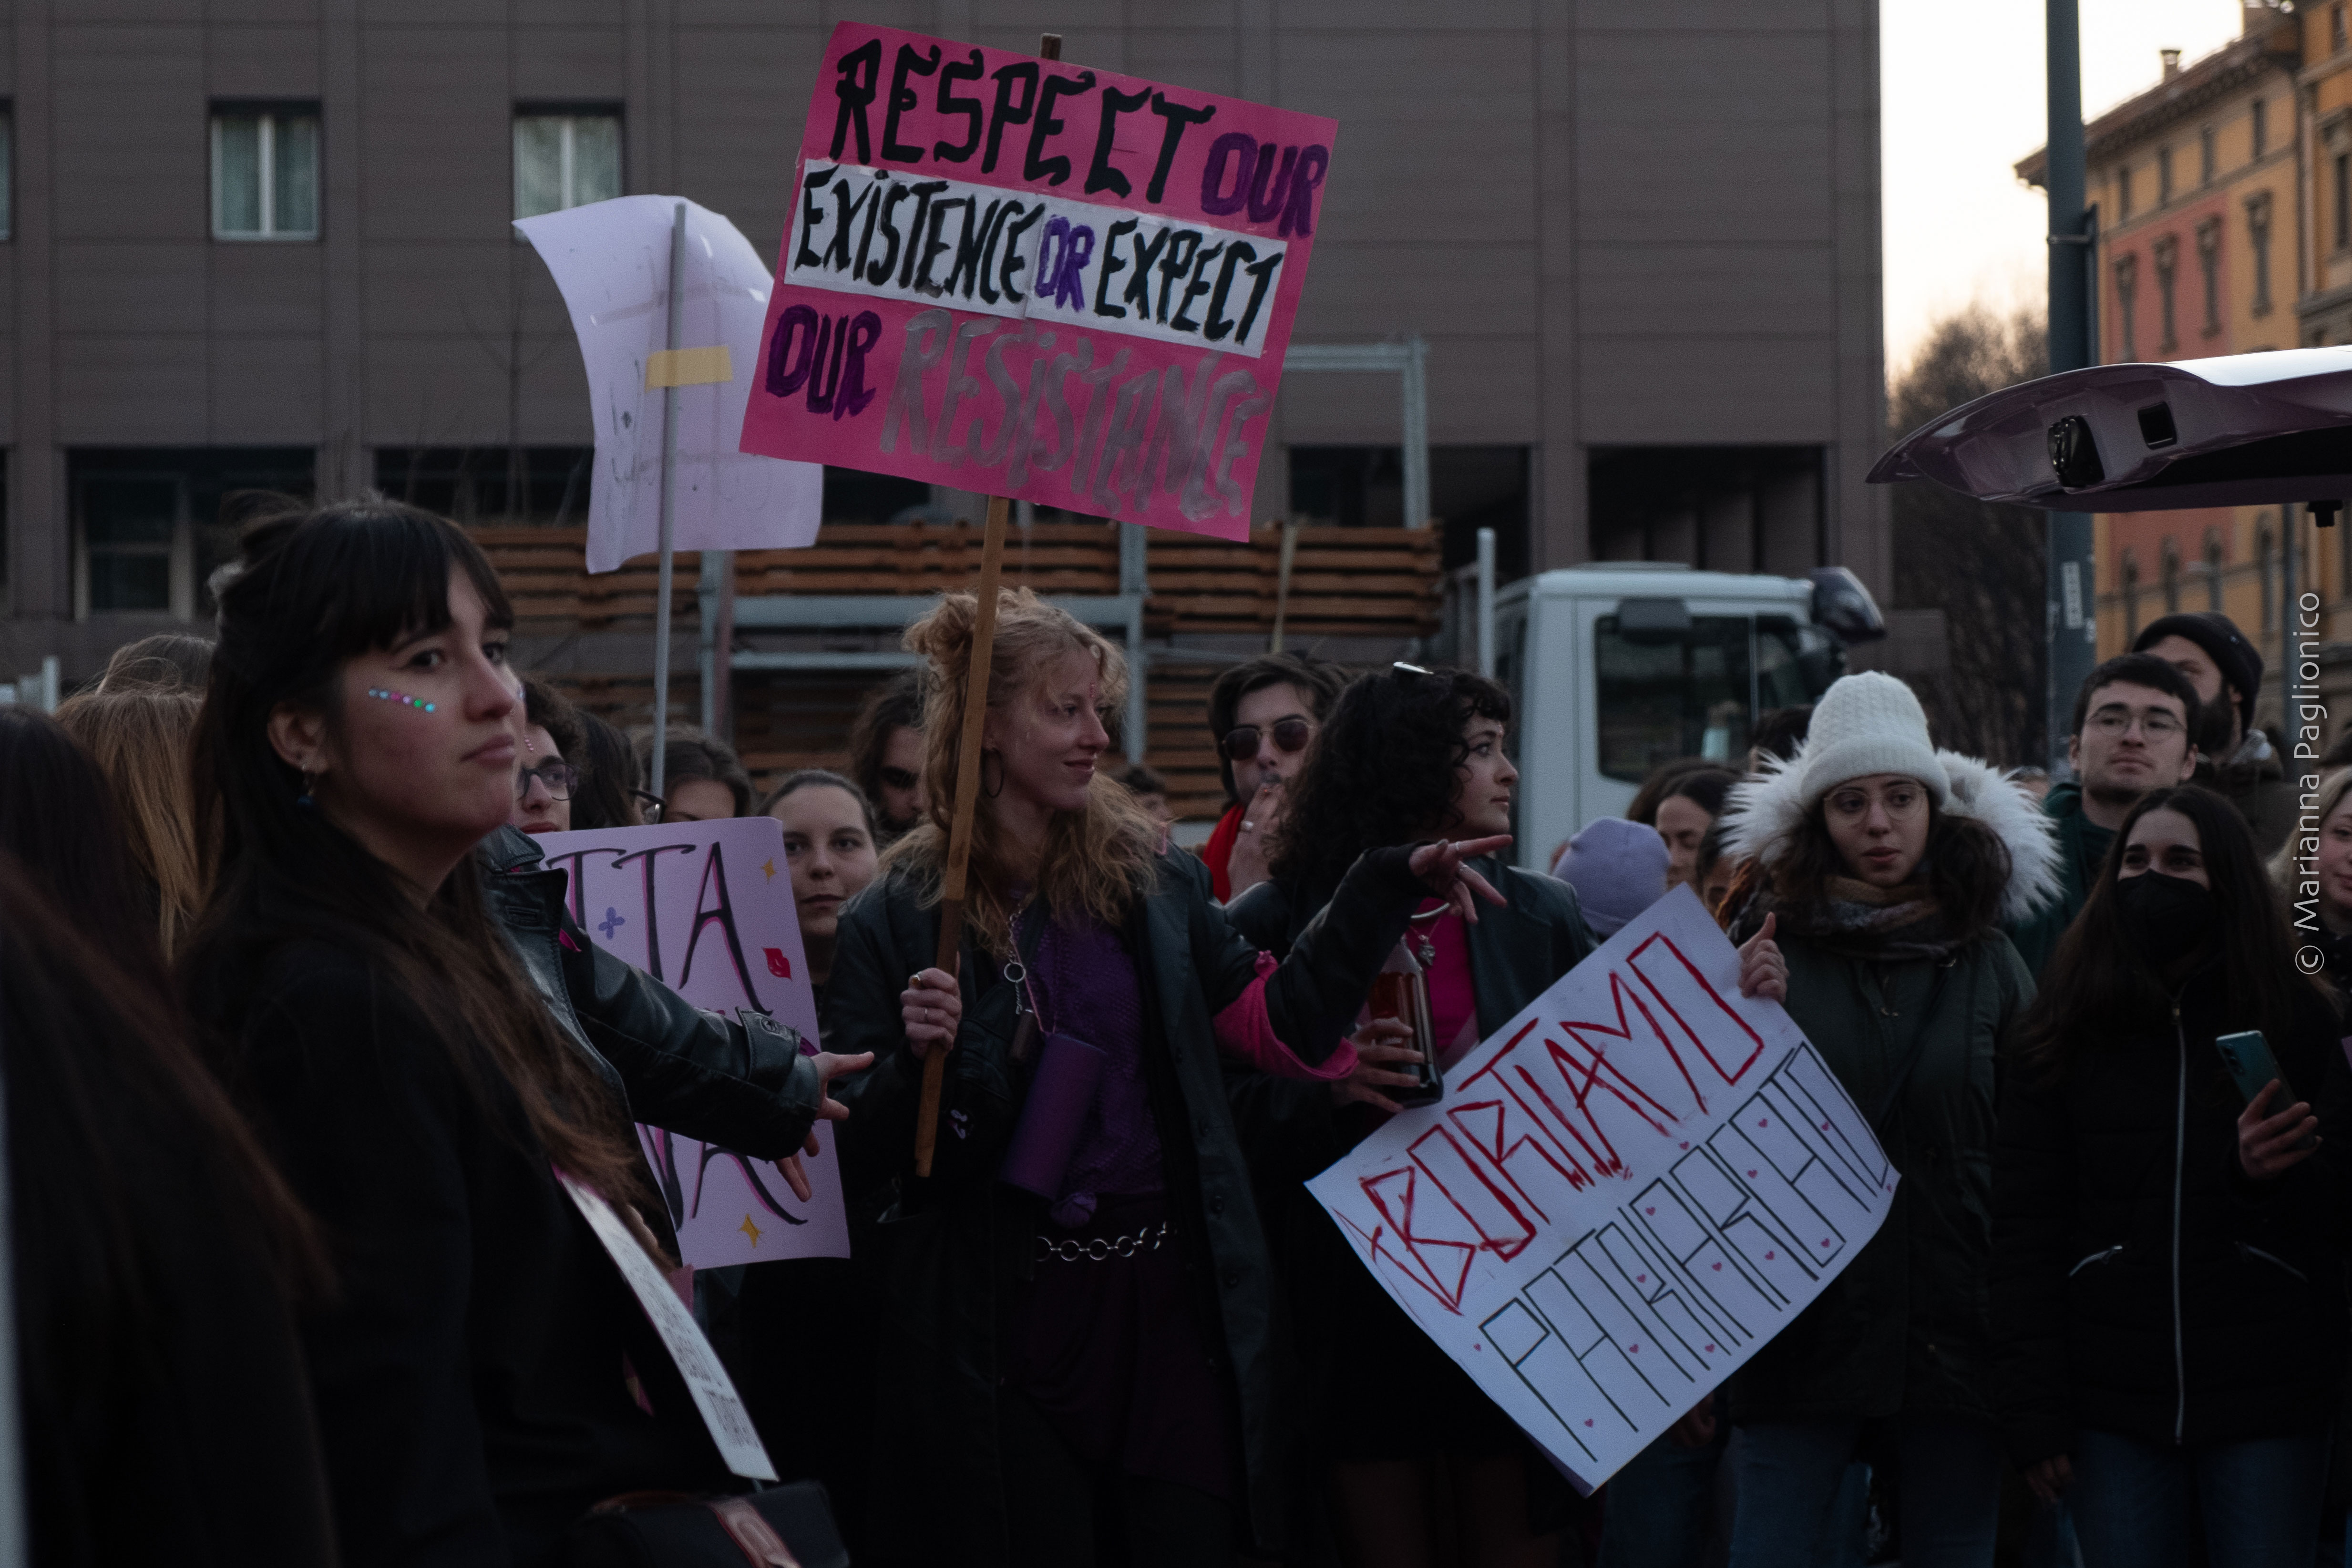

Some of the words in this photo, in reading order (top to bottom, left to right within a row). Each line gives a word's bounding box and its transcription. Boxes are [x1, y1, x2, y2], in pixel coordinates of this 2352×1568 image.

[830, 38, 1216, 204] RESPECT
[1200, 132, 1329, 238] OUR
[794, 164, 1046, 304] EXISTENCE
[1034, 215, 1095, 312] OR
[1094, 218, 1284, 345] EXPECT
[765, 304, 883, 420] OUR
[879, 308, 1272, 522] RESISTANCE
[1479, 1041, 1890, 1463] PATRIARCATO
